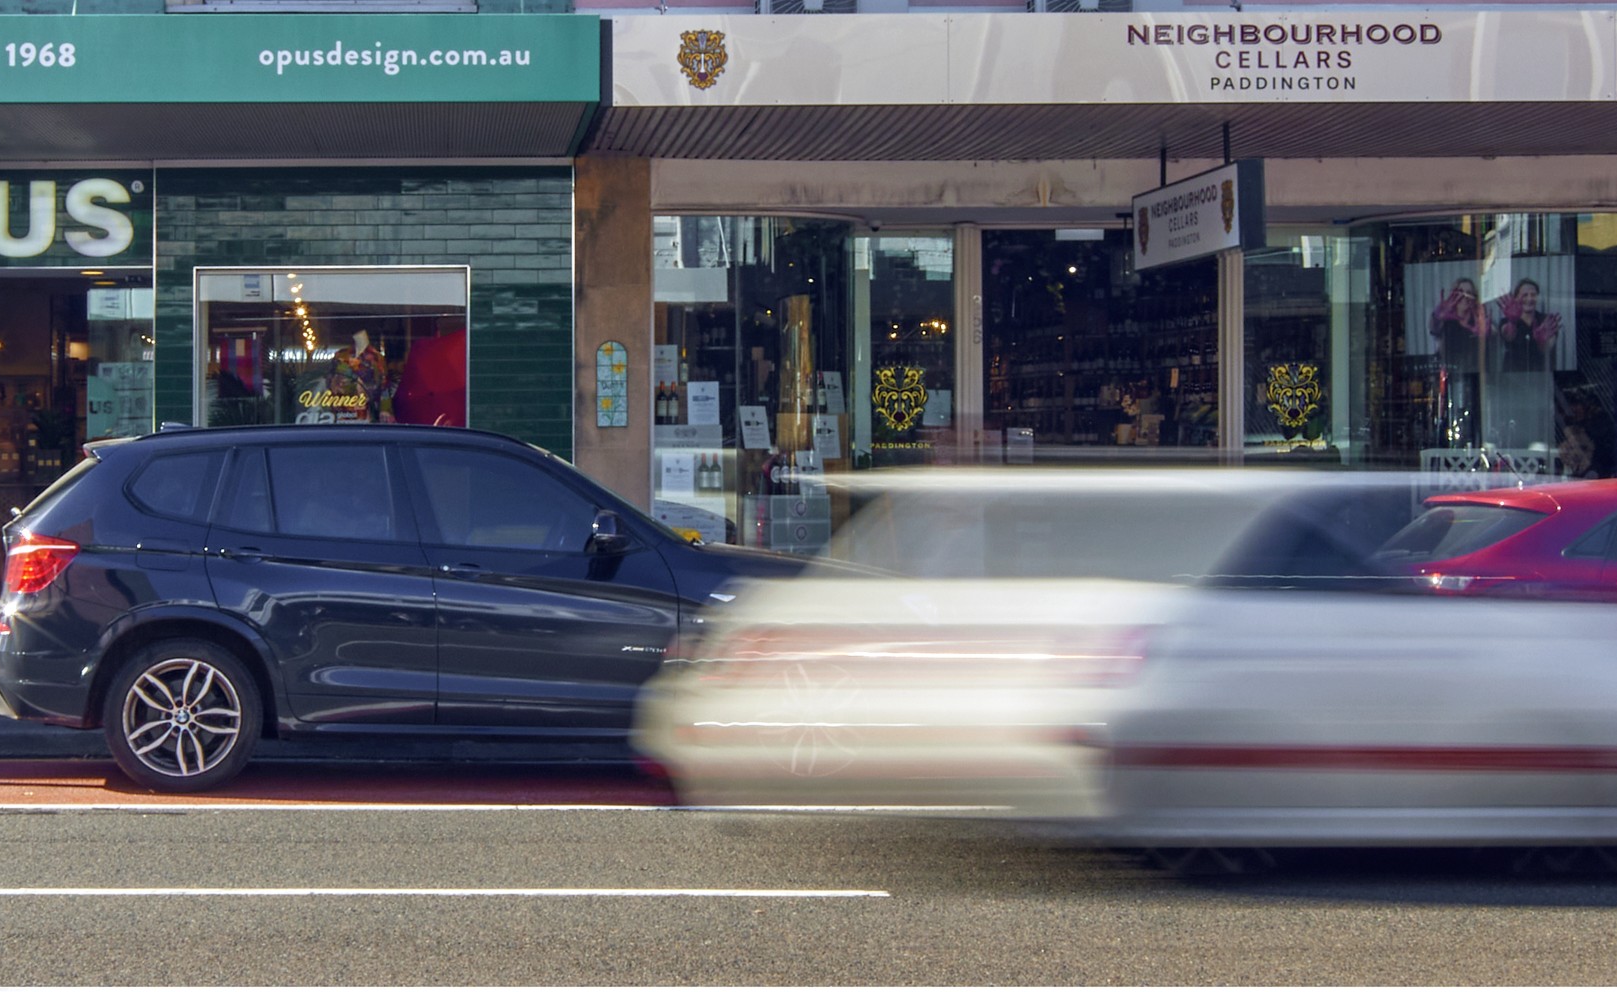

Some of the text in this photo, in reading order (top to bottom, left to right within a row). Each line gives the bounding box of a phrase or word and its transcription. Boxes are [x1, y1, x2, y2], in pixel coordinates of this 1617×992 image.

[1126, 24, 1442, 46] NEIGHBOURHOOD
[5, 42, 77, 68] 1968
[258, 40, 531, 75] opusdesign.com.au
[1215, 51, 1353, 69] CELLARS
[1210, 76, 1357, 91] PADDINGTON
[1150, 184, 1218, 219] NEIGHBOURHOOD
[1168, 210, 1199, 233] CELLARS
[298, 389, 369, 408] Winner
